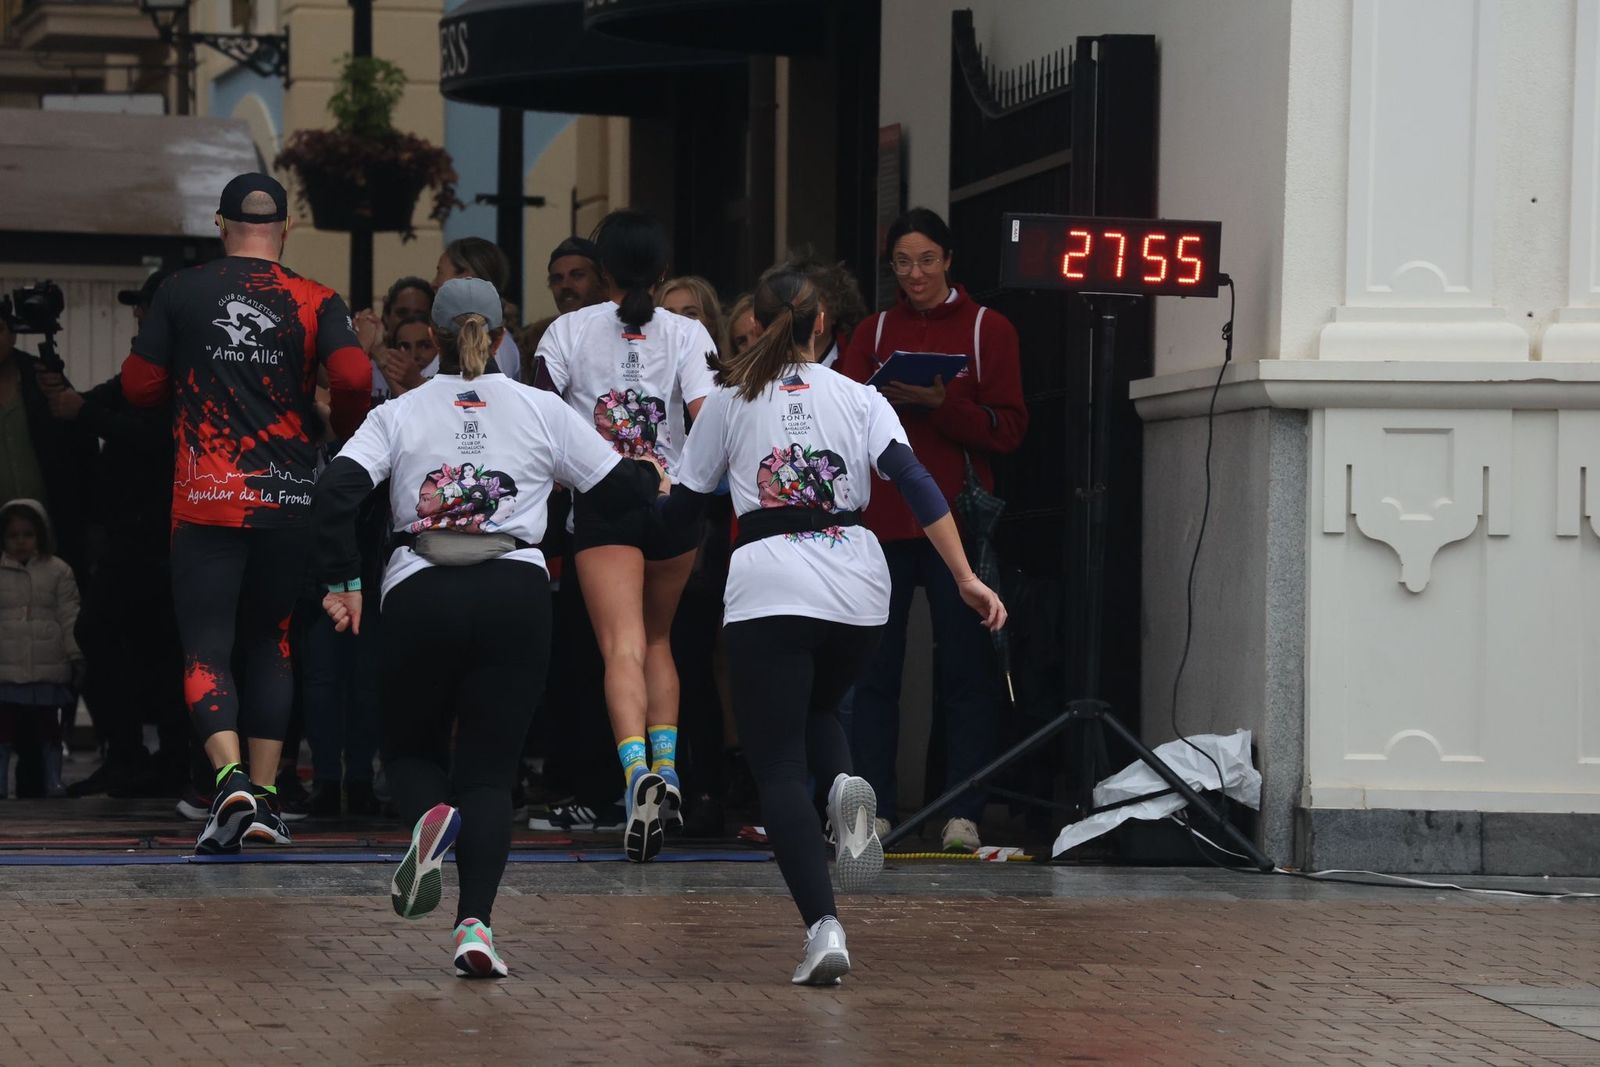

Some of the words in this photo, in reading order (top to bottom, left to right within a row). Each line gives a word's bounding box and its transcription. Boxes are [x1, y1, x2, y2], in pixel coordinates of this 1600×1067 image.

[218, 293, 235, 307] CLUB
[236, 294, 247, 303] DE
[247, 300, 281, 323] ATLETISMO
[187, 486, 235, 504] Aguilar
[239, 486, 256, 501] de
[260, 489, 274, 502] la
